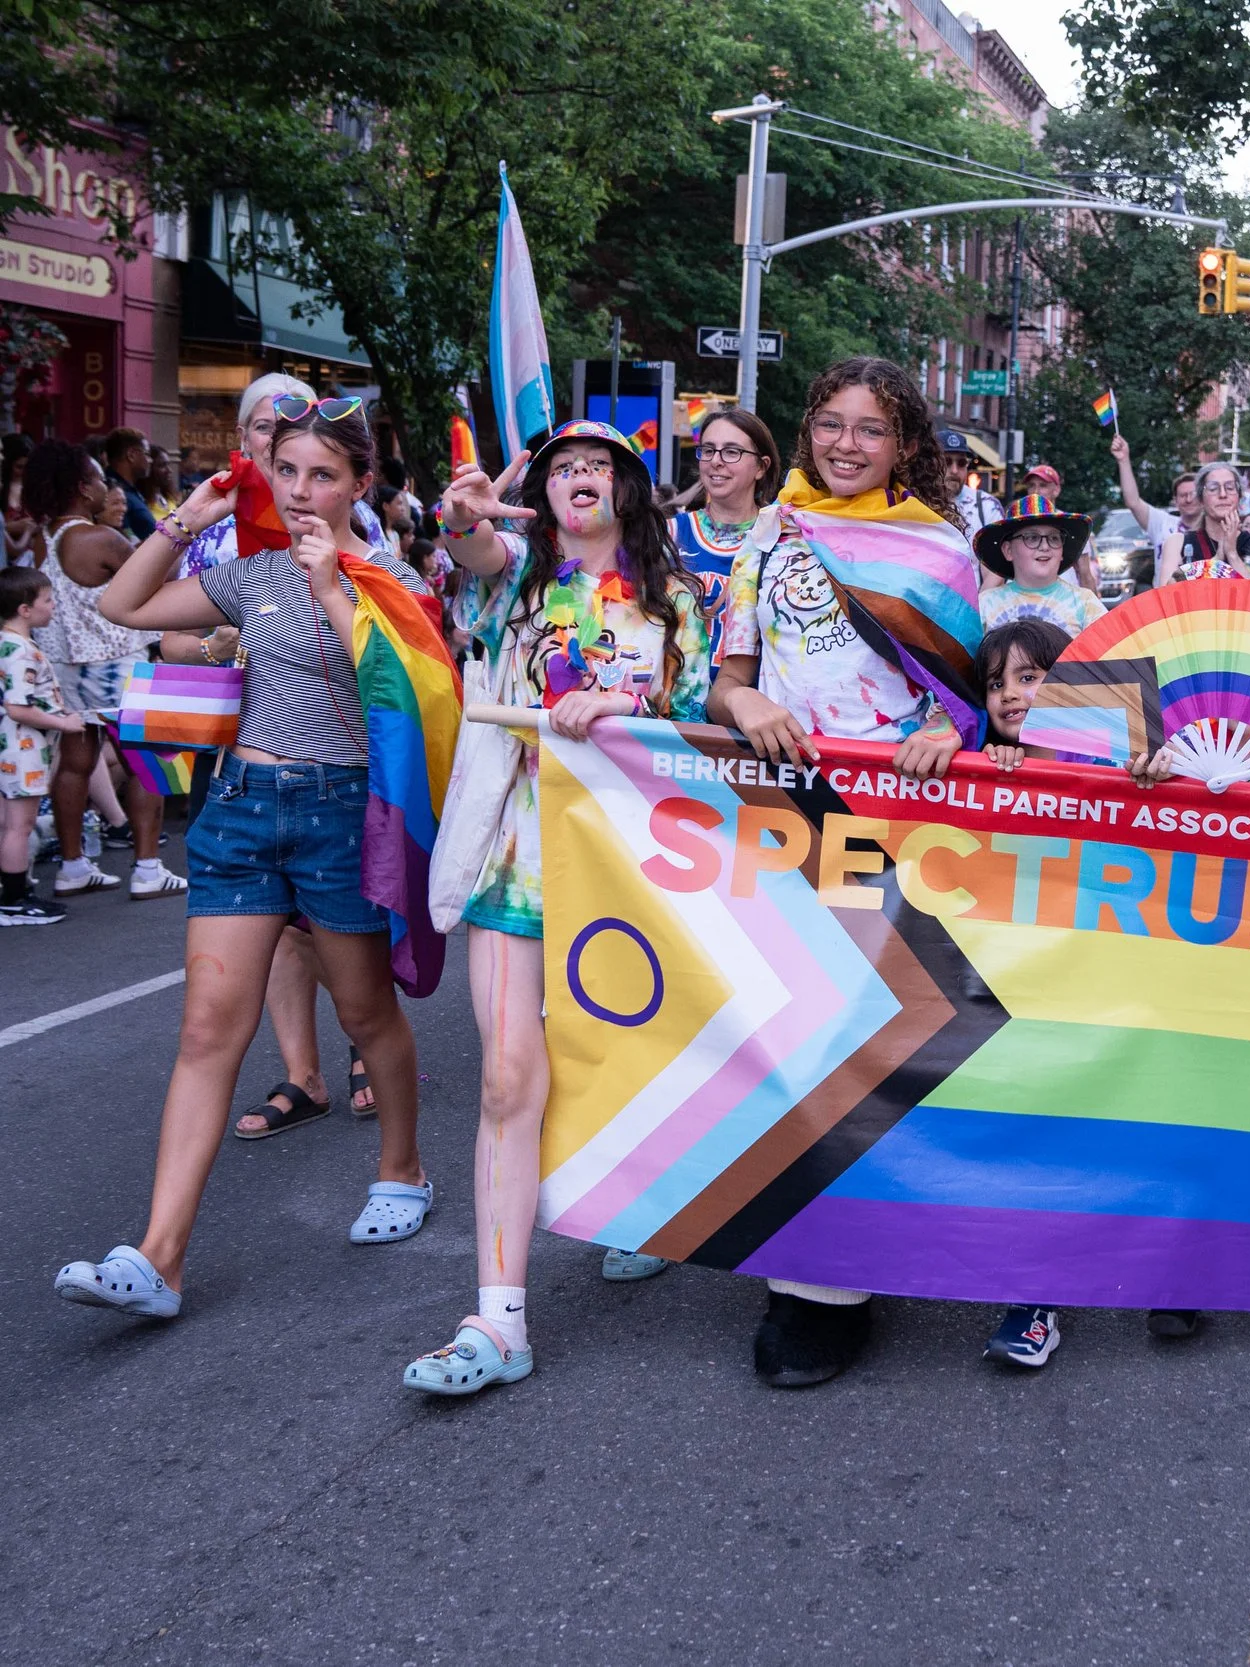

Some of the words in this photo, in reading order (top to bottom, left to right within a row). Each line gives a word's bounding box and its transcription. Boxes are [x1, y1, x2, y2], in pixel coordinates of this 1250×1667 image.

[5, 125, 135, 237] Shop
[28, 253, 96, 287] STUDIO
[714, 339, 740, 350] ONE
[83, 351, 104, 428] BOU
[806, 619, 859, 655] prid
[652, 751, 821, 790] BERKELEY
[828, 768, 985, 812] CARROLL
[992, 786, 1125, 825] PARENT
